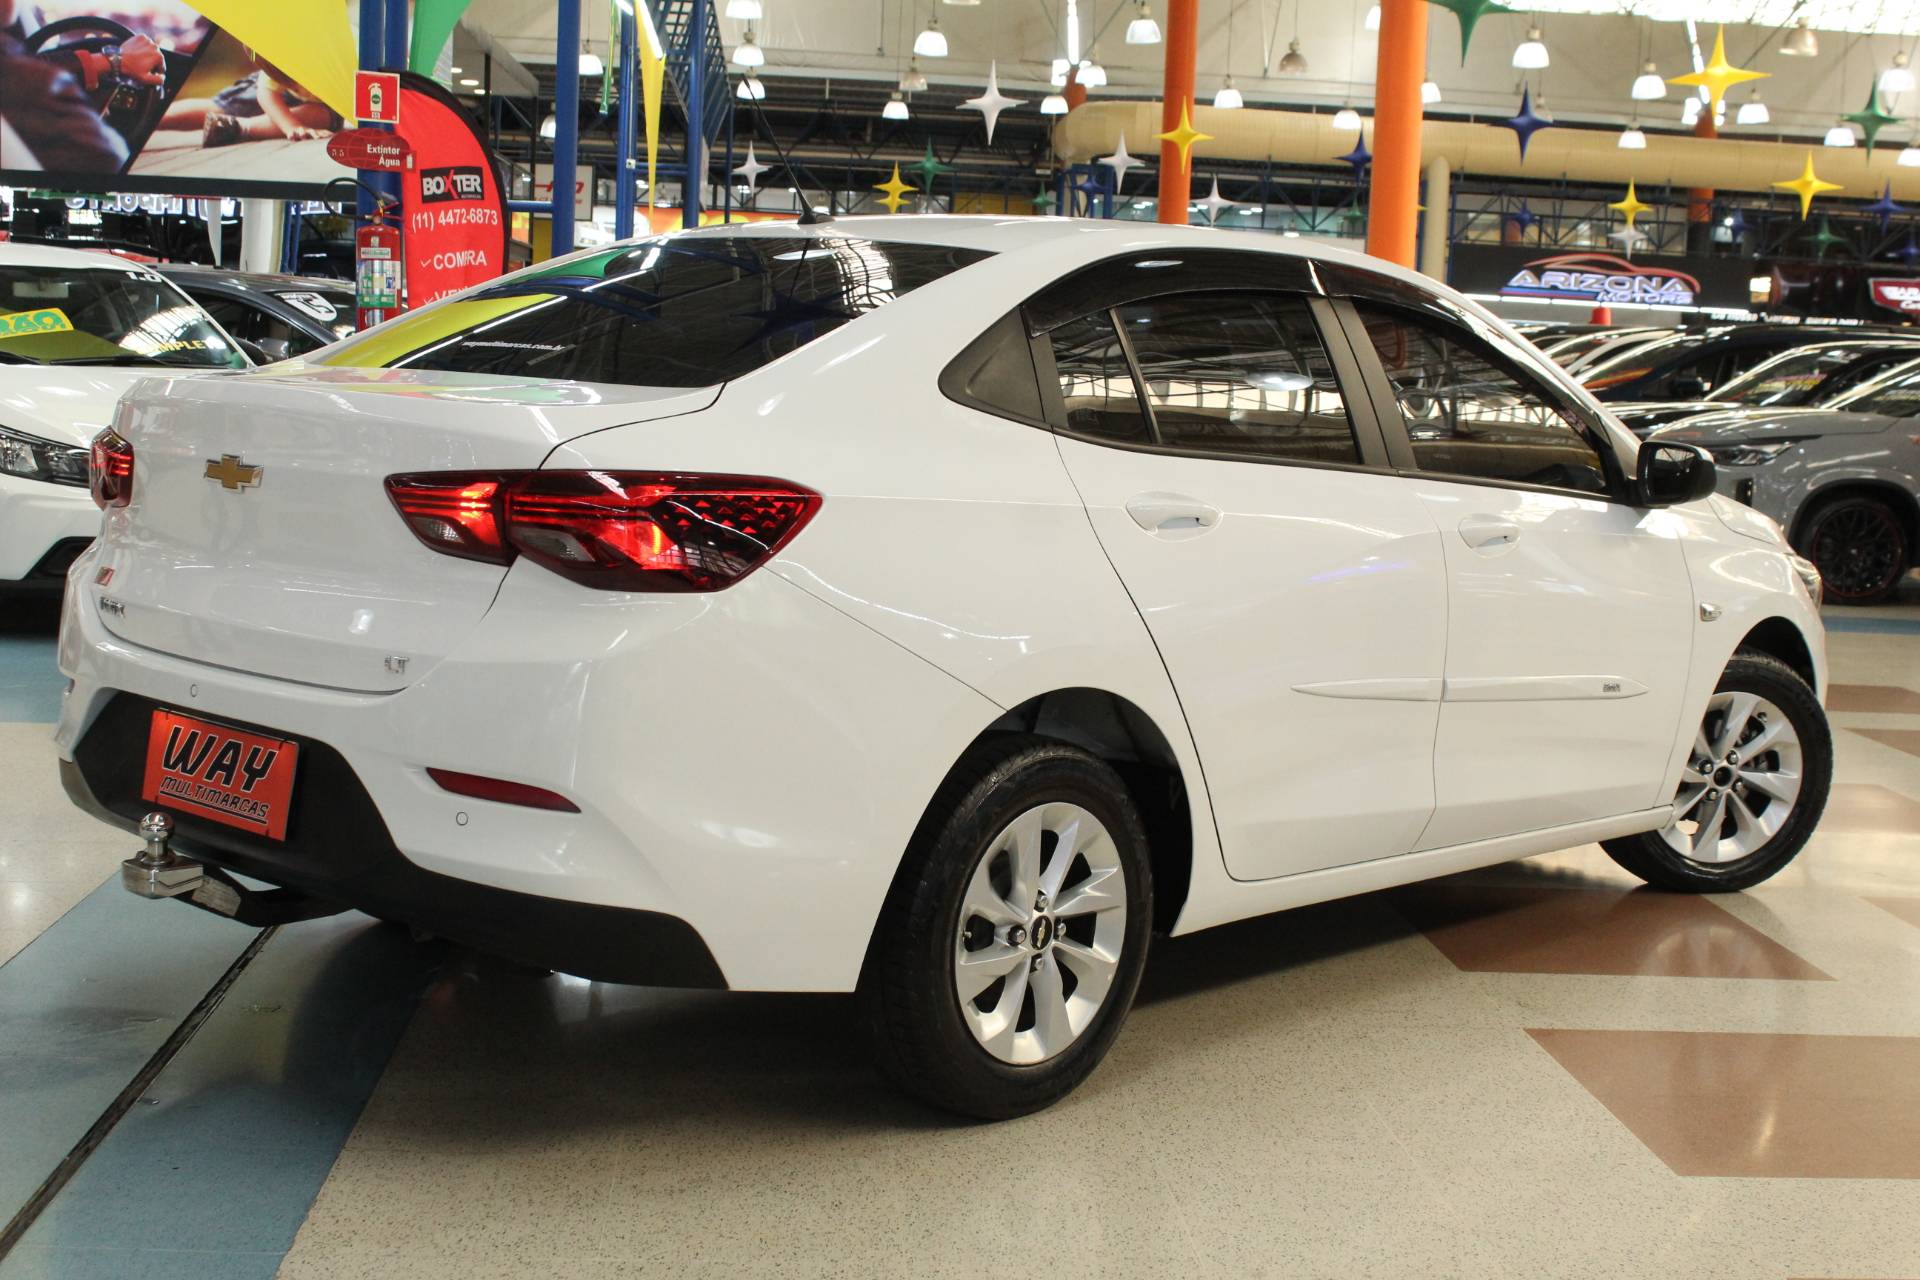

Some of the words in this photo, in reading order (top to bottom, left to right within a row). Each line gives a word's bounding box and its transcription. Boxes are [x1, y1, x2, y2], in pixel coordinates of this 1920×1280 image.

[366, 144, 401, 155] Extintor
[378, 154, 401, 168] Água
[422, 169, 483, 199] BOXTER
[412, 211, 435, 233] (11)
[438, 208, 498, 226] 4472-6873
[1508, 269, 1693, 296] ARIZONA
[1596, 292, 1694, 305] MOTORS
[161, 724, 279, 793] WAY
[160, 775, 271, 818] MULTIMARCAS
